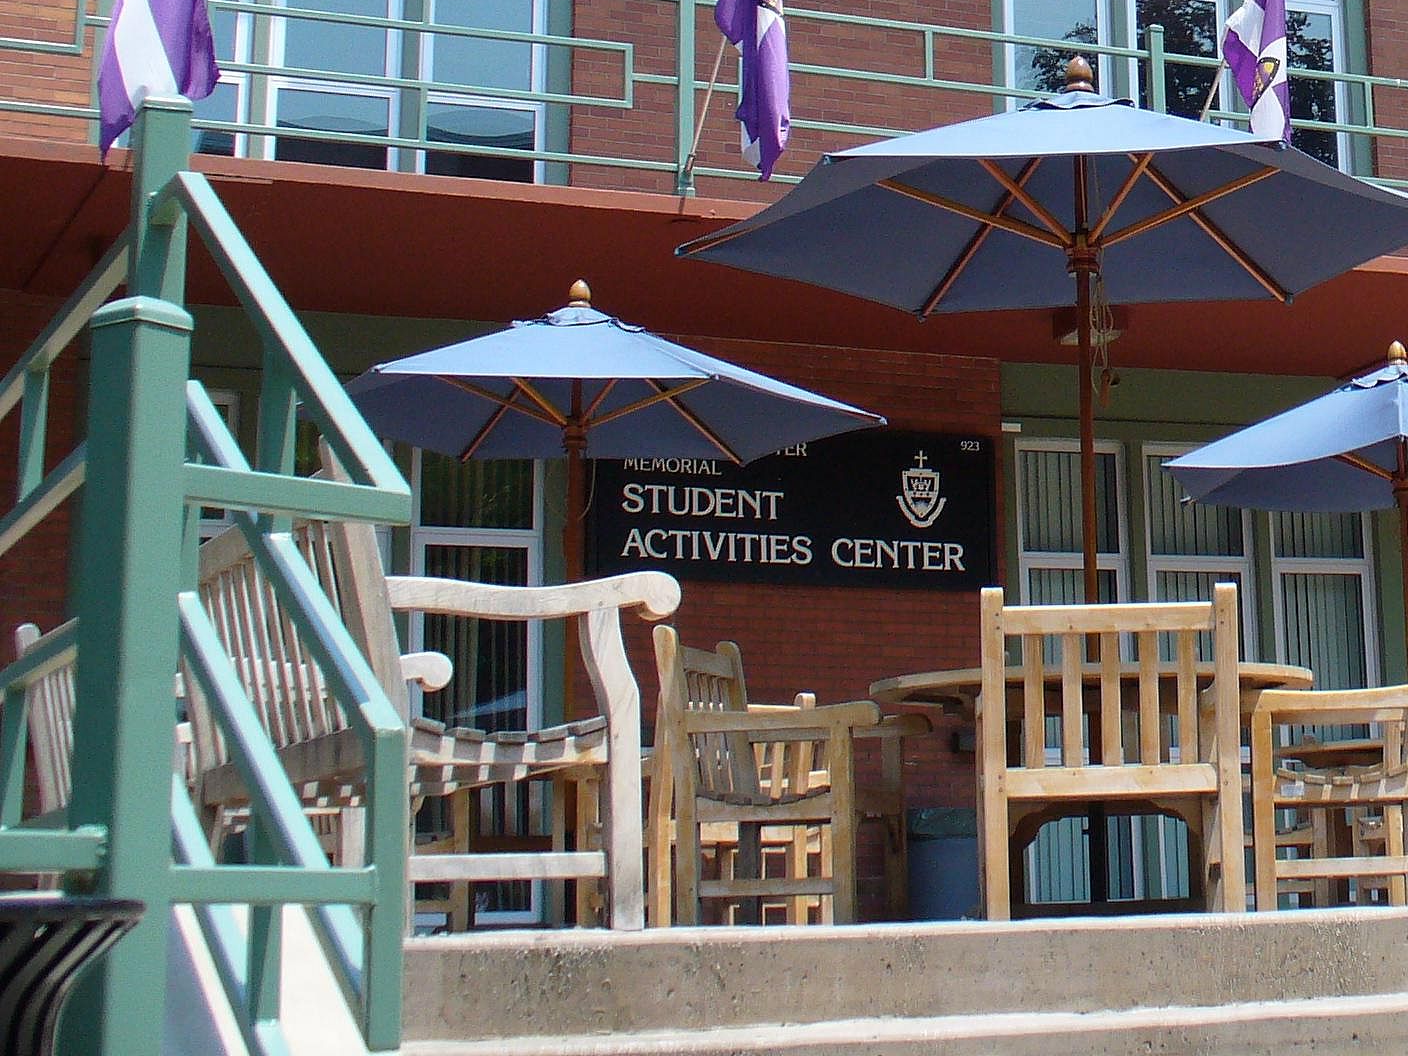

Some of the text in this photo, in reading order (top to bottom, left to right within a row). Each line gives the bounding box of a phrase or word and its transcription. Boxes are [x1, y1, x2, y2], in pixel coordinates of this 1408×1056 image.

[960, 440, 981, 452] 923
[623, 457, 723, 476] MEMORIAL
[621, 483, 785, 521] STUDENT
[620, 528, 966, 572] ACTIVITIES CENTER
